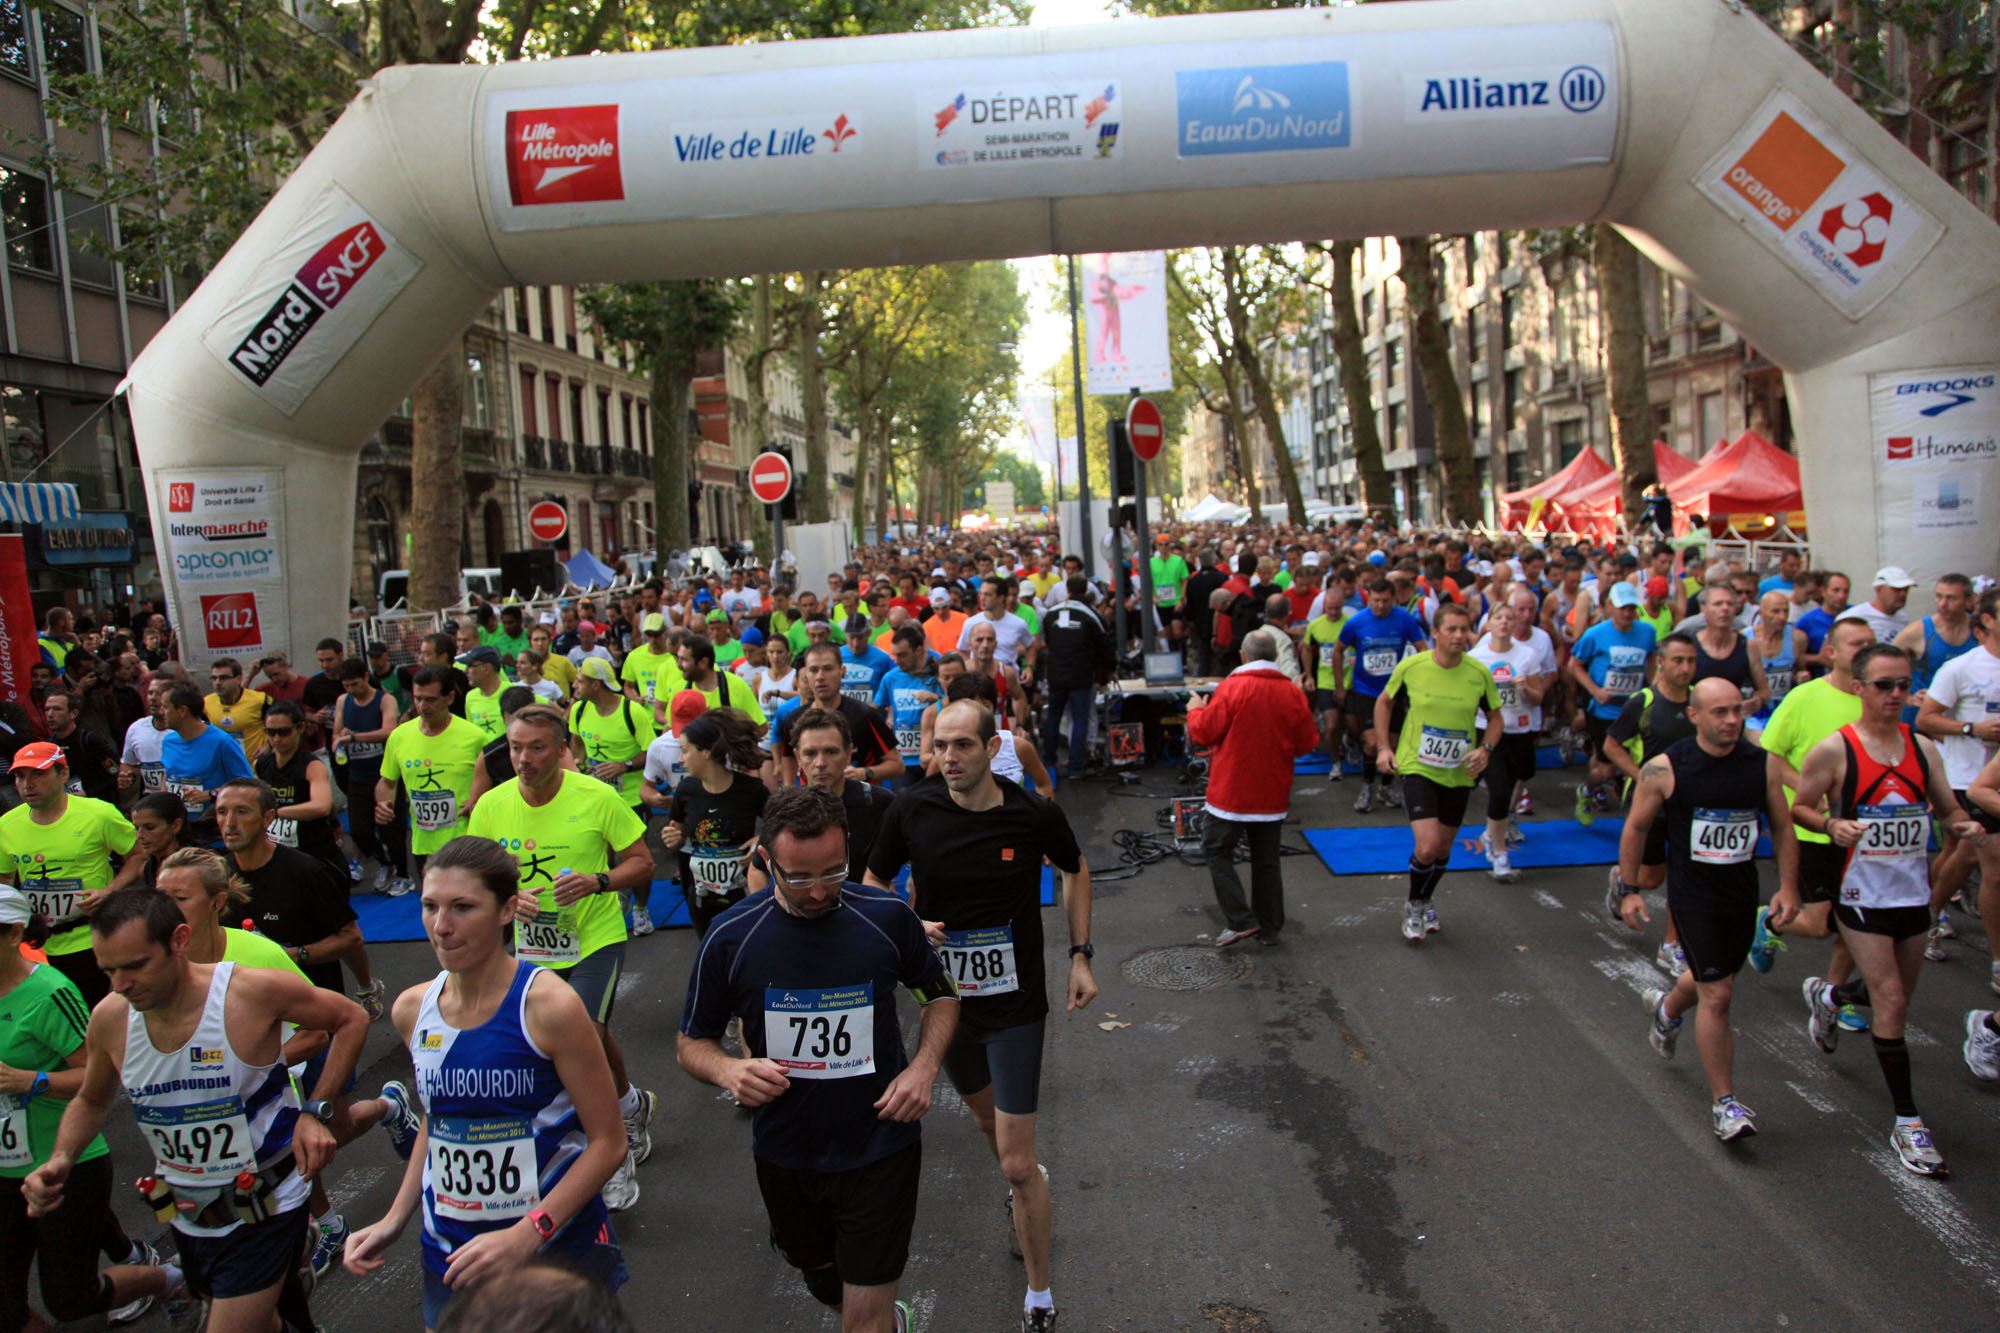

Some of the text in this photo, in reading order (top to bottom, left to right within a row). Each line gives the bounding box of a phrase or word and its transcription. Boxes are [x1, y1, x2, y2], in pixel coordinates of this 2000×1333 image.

[1421, 75, 1549, 111] Allianz
[971, 91, 1079, 124] DÉPART
[521, 122, 557, 142] Lille
[985, 131, 1070, 146] SEMI-MARATHON
[1185, 111, 1342, 144] EauxDuNord
[522, 137, 614, 163] Métropole
[674, 127, 816, 162] Ville de Lille
[1730, 166, 1793, 222] orange
[316, 226, 373, 302] SNCF
[236, 289, 313, 375] Nord
[1896, 375, 1995, 395] BROOKS
[1917, 435, 1998, 459] Humanis
[176, 550, 269, 572] aptonia
[208, 607, 254, 631] RTL2
[1424, 737, 1460, 759] 3476
[415, 801, 450, 821] 3599
[1698, 824, 1751, 850] 4069
[1867, 820, 1922, 847] 3502
[697, 860, 739, 884] 1002
[28, 892, 75, 917] 3617
[522, 922, 571, 949] 3603
[940, 948, 1005, 982] 1788
[789, 1014, 852, 1058] 736
[425, 1067, 535, 1098] HAUBOURDIN
[153, 1123, 239, 1164] 3492
[438, 1145, 521, 1196] 3336
[485, 1199, 527, 1211] Ville de Lille
